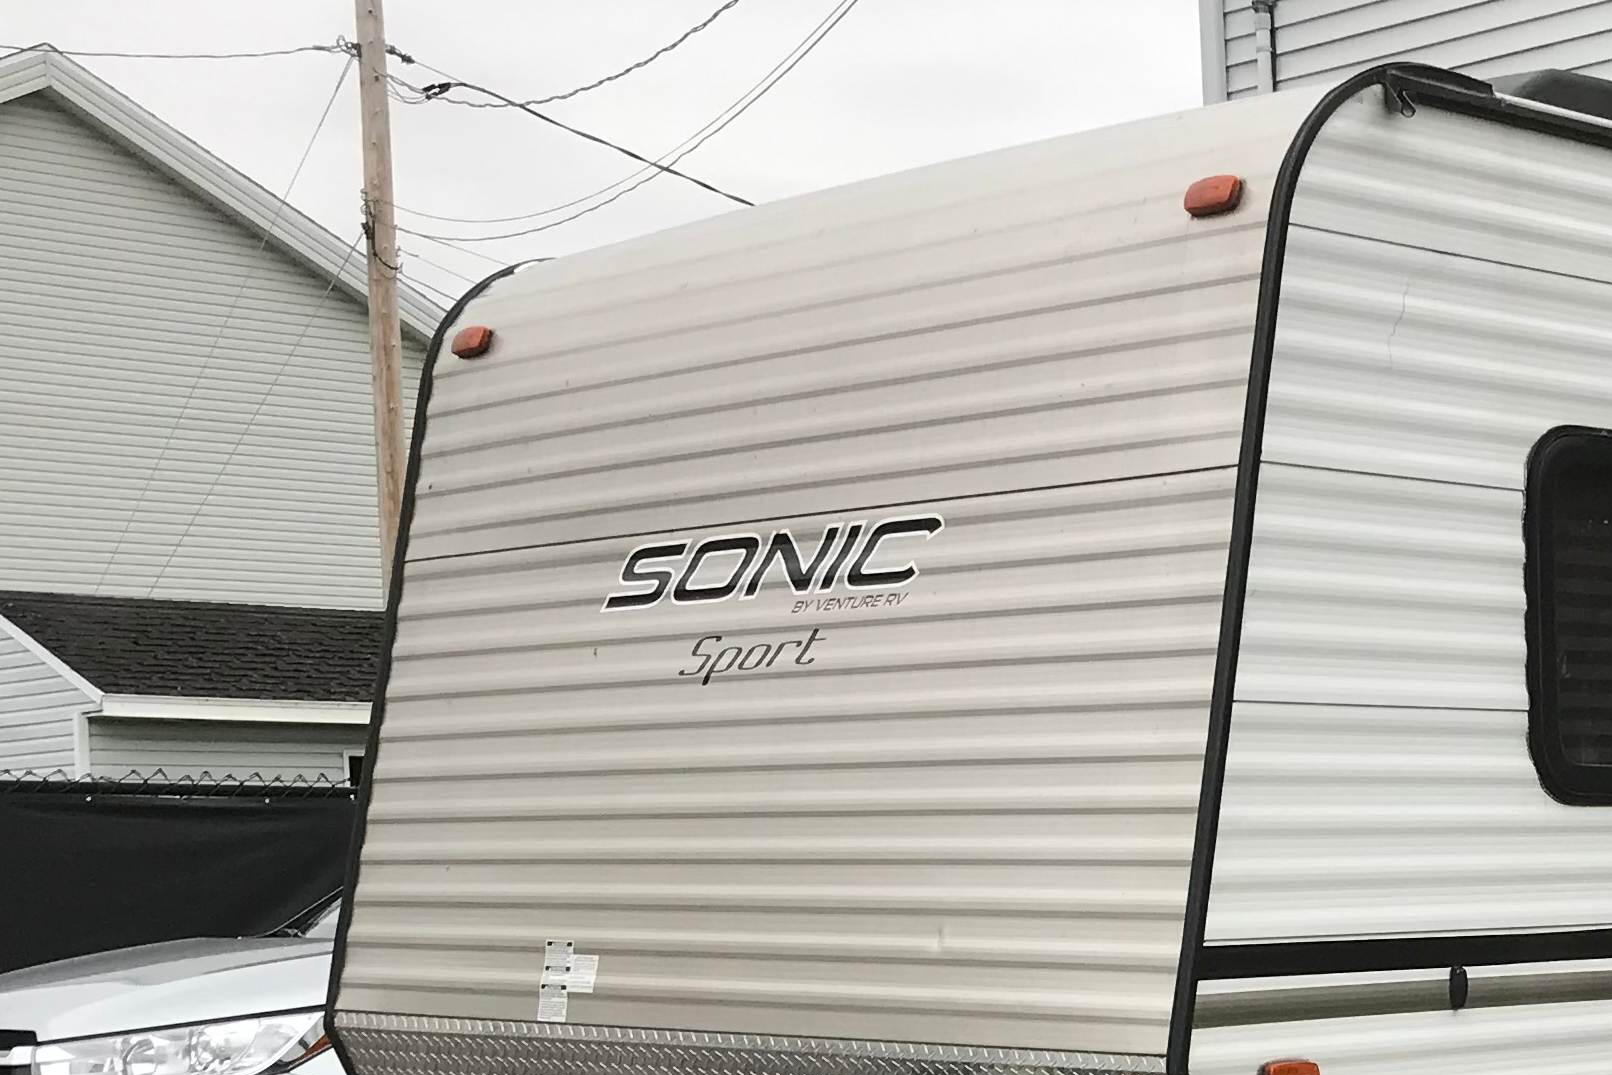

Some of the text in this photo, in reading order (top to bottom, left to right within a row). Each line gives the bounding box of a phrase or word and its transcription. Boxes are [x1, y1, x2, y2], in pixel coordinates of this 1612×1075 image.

[602, 514, 945, 612] SONIC
[791, 592, 909, 614] BY VENTURE RV
[678, 627, 827, 686] Sport
